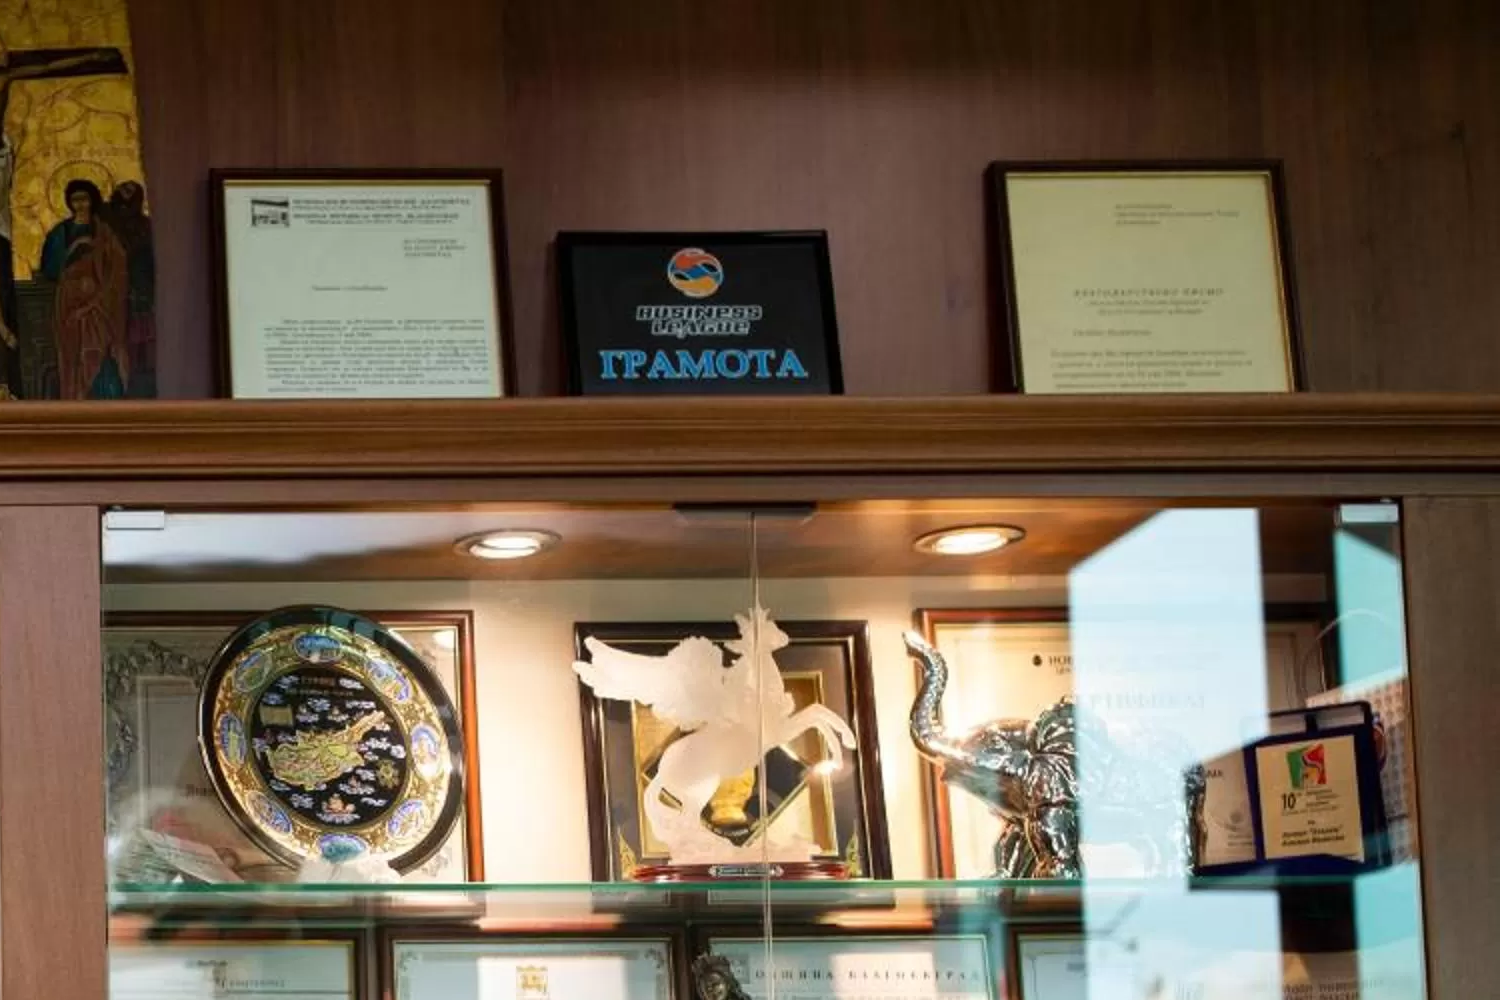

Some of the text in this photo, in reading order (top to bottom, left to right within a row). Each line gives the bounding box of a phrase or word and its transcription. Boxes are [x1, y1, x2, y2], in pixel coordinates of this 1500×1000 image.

[635, 305, 763, 321] BUSINESS
[651, 319, 751, 339] LEAGUE
[598, 349, 809, 379] ГРАМОТА
[1281, 792, 1297, 809] 10
